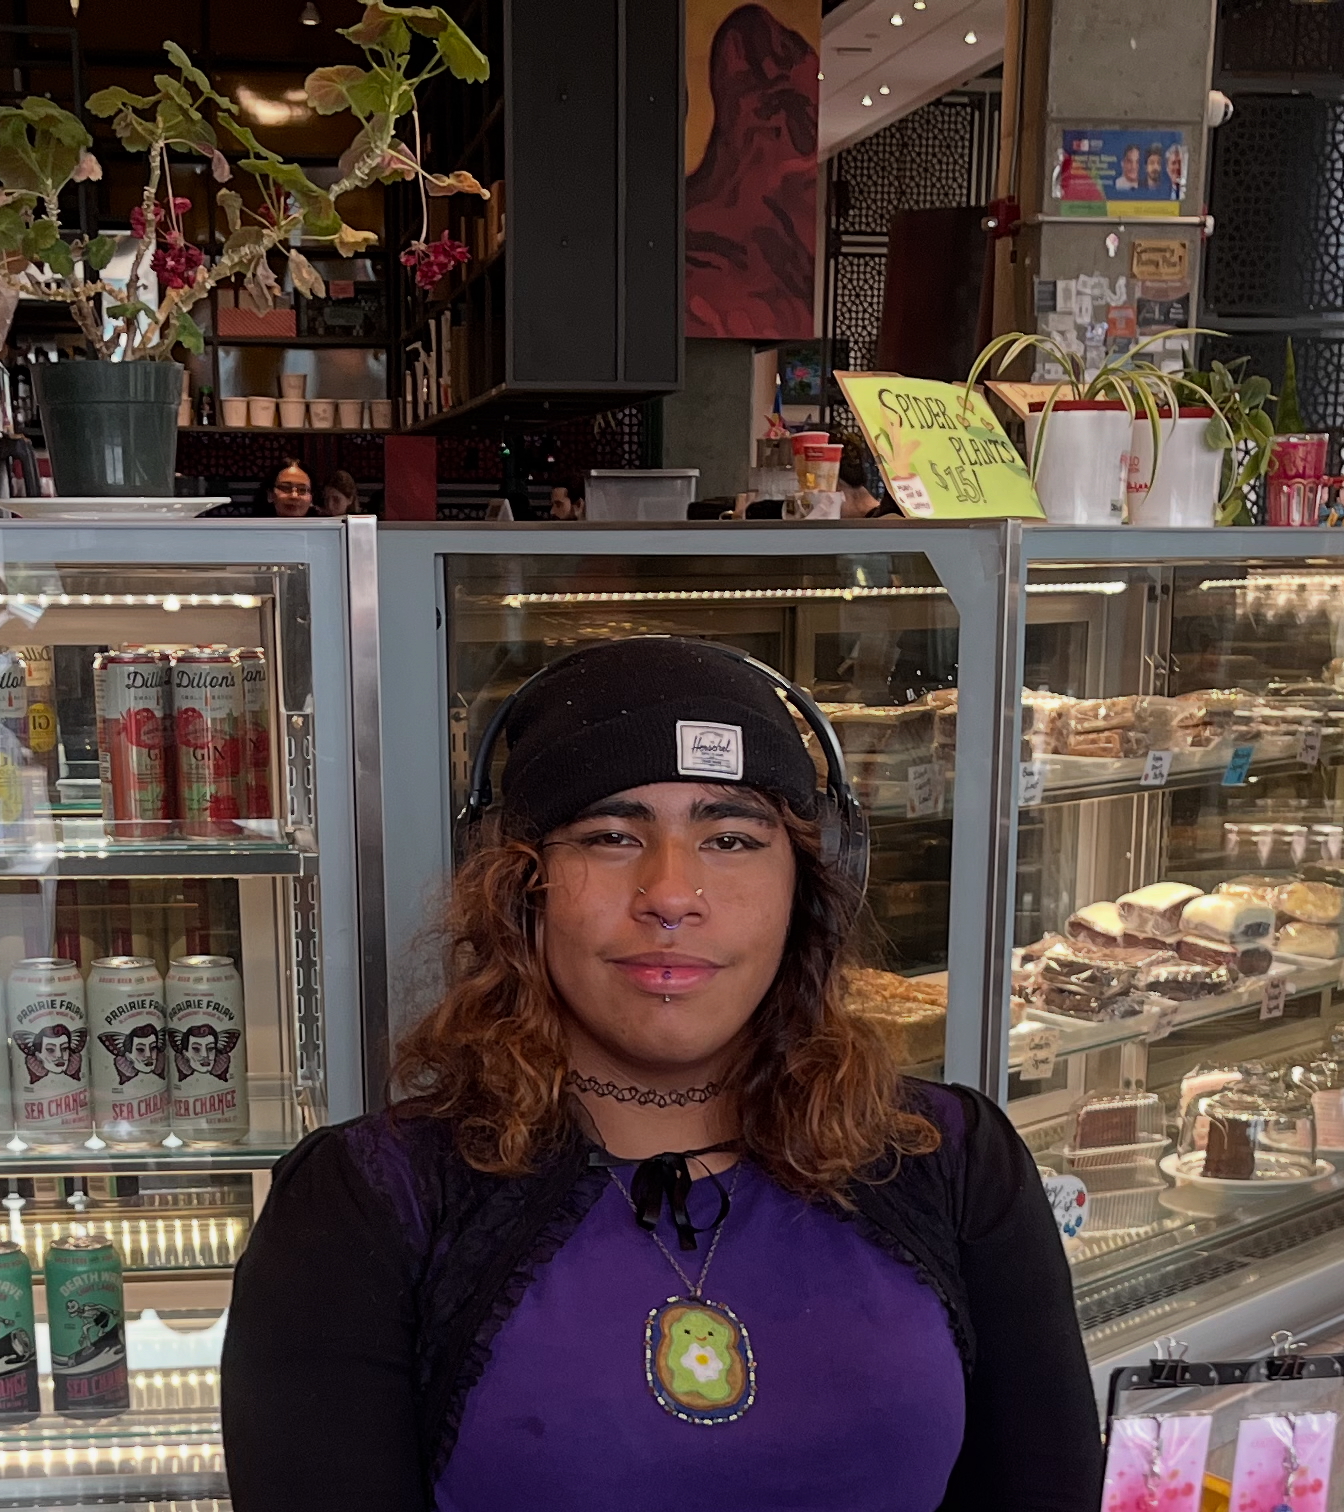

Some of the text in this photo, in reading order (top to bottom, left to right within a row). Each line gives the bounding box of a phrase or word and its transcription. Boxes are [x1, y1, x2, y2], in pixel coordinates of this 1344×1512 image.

[878, 389, 956, 429] SPIDER
[949, 437, 1014, 466] PLANTS
[929, 460, 987, 504] $15!
[176, 670, 235, 688] Dillon's
[193, 746, 225, 761] GIN
[16, 999, 84, 1024] PRAIRIE FAIRY
[105, 999, 146, 1025] PRAIRIE
[206, 1000, 234, 1020] FAIRY
[25, 1089, 88, 1119] SEA CHANGE
[112, 1101, 134, 1119] SEA
[193, 1090, 236, 1115] CHANGE
[60, 1272, 99, 1297] DEATH
[66, 1379, 88, 1398] SEA
